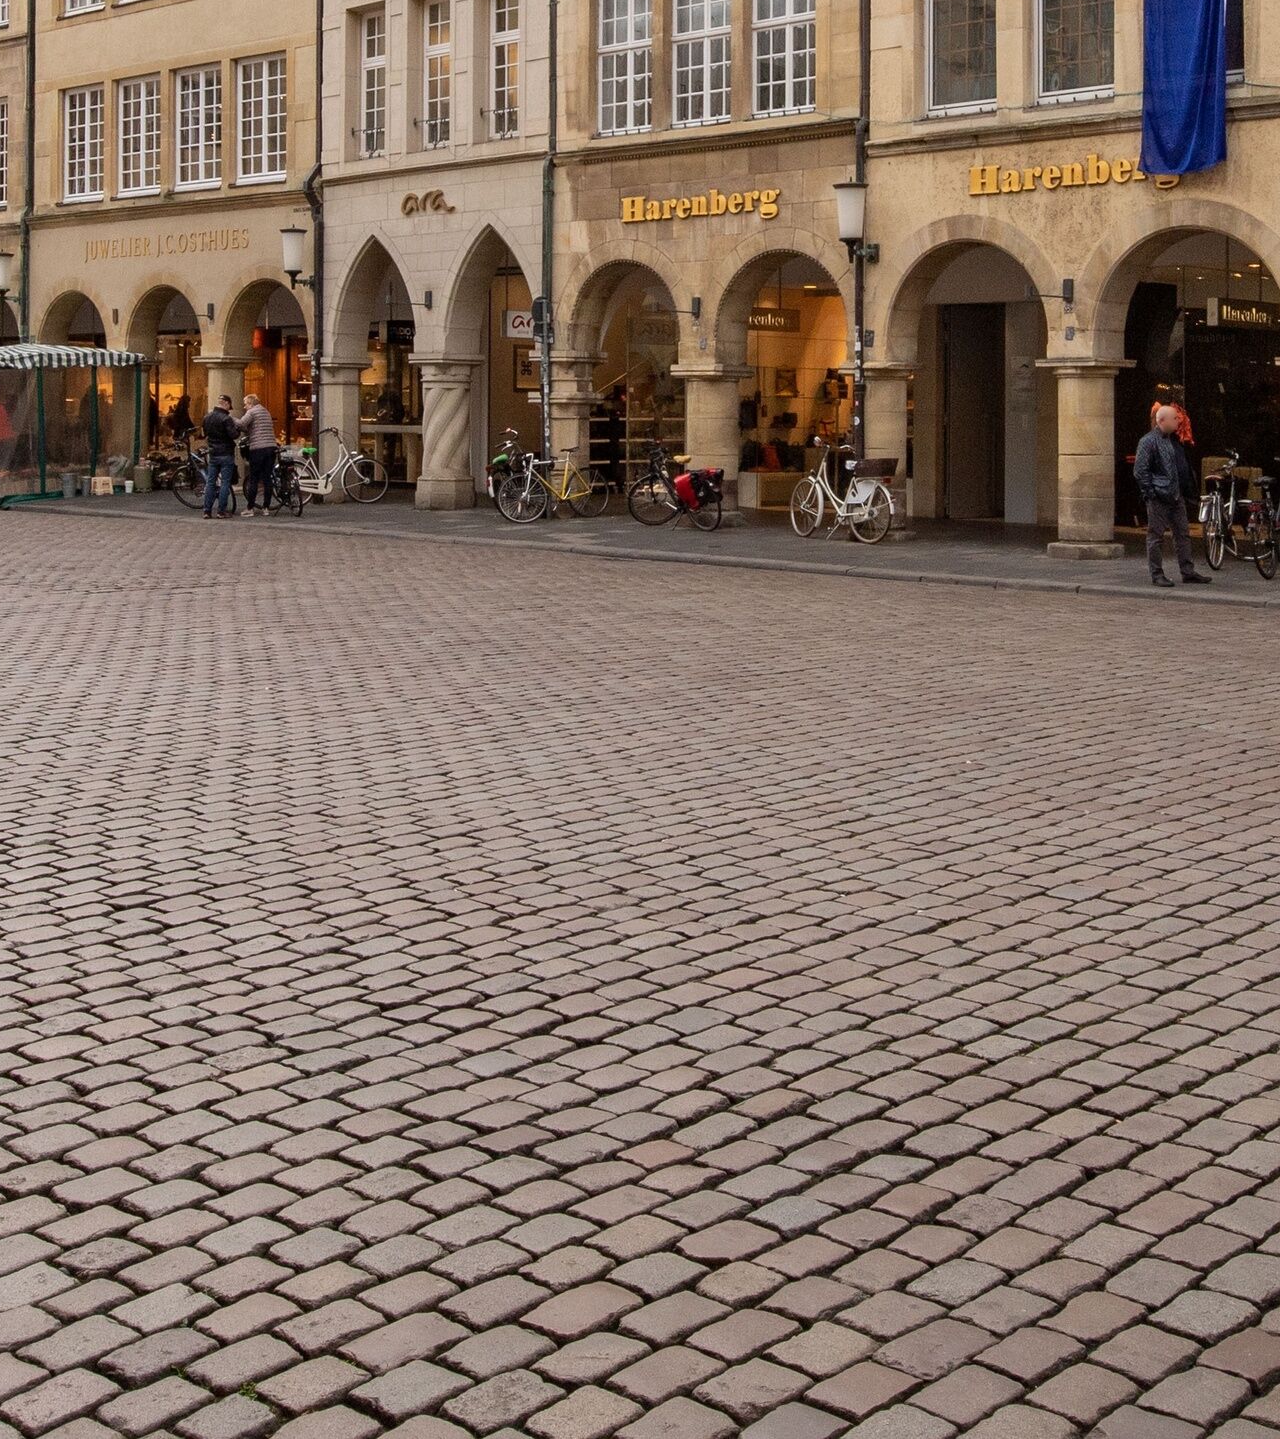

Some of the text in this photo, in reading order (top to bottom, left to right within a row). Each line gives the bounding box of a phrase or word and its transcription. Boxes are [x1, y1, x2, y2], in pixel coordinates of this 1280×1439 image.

[401, 189, 456, 216] ara
[621, 188, 781, 224] Harenberg
[84, 237, 152, 263] JUWELIER
[512, 314, 534, 329] ar
